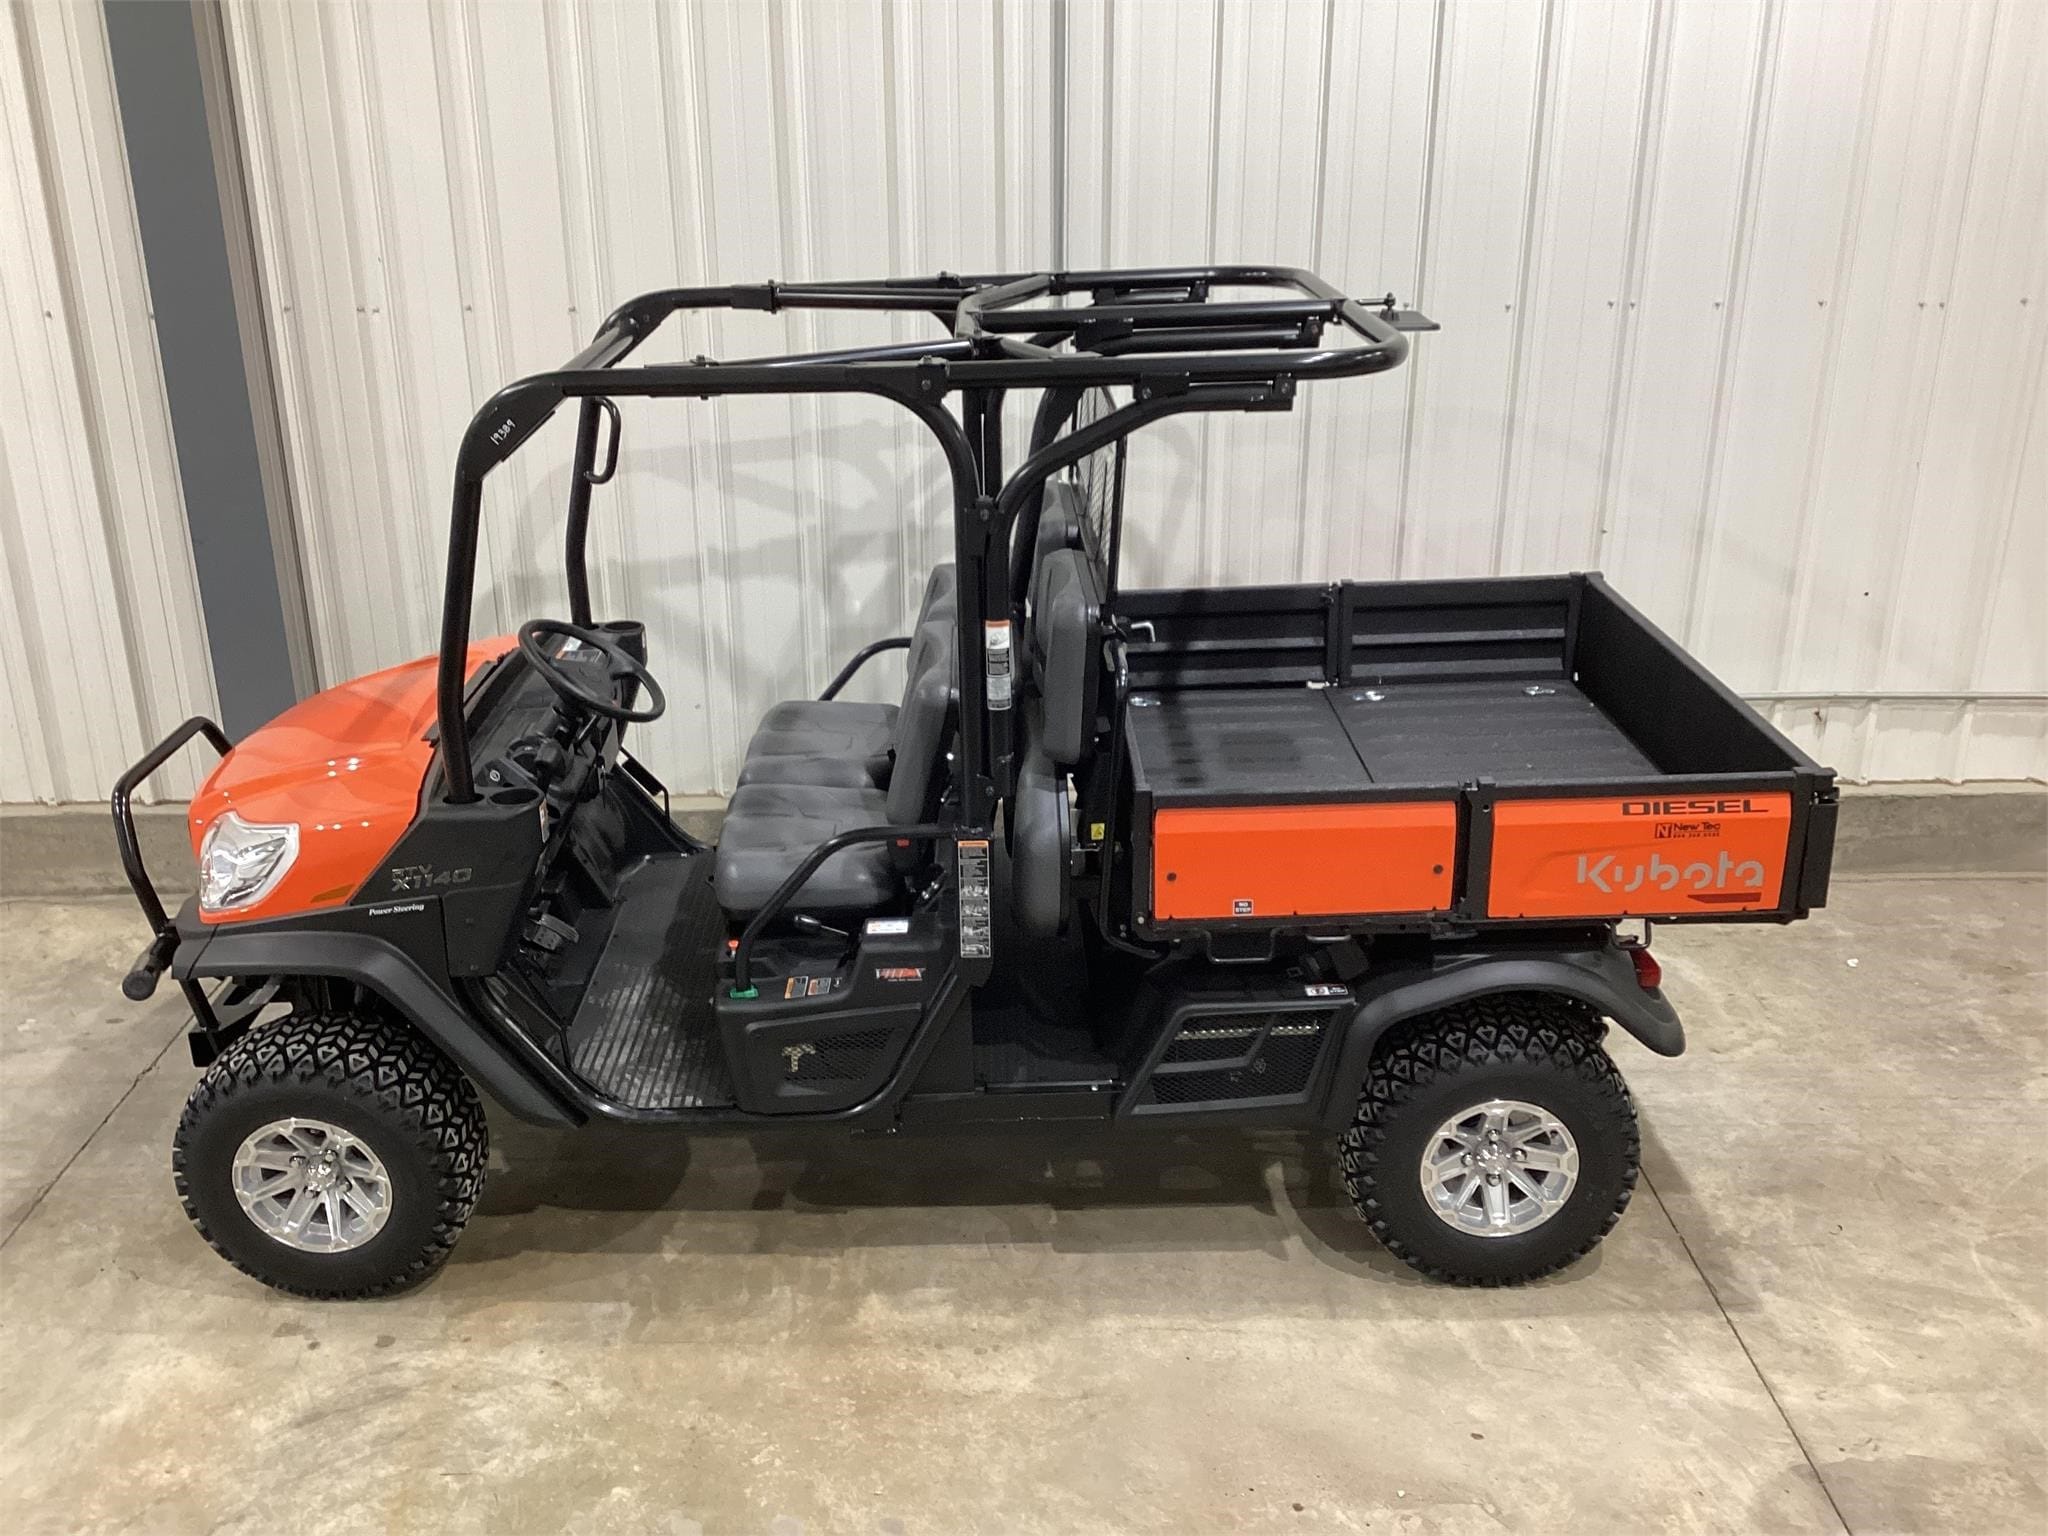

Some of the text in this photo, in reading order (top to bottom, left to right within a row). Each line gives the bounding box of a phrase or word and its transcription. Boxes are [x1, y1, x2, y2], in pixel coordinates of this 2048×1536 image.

[1622, 799, 1769, 816] DIESEL
[1674, 821, 1721, 831] New Tec
[391, 867, 473, 892] X1140
[1577, 850, 1765, 893] Kubota
[369, 902, 425, 917] Power Steering
